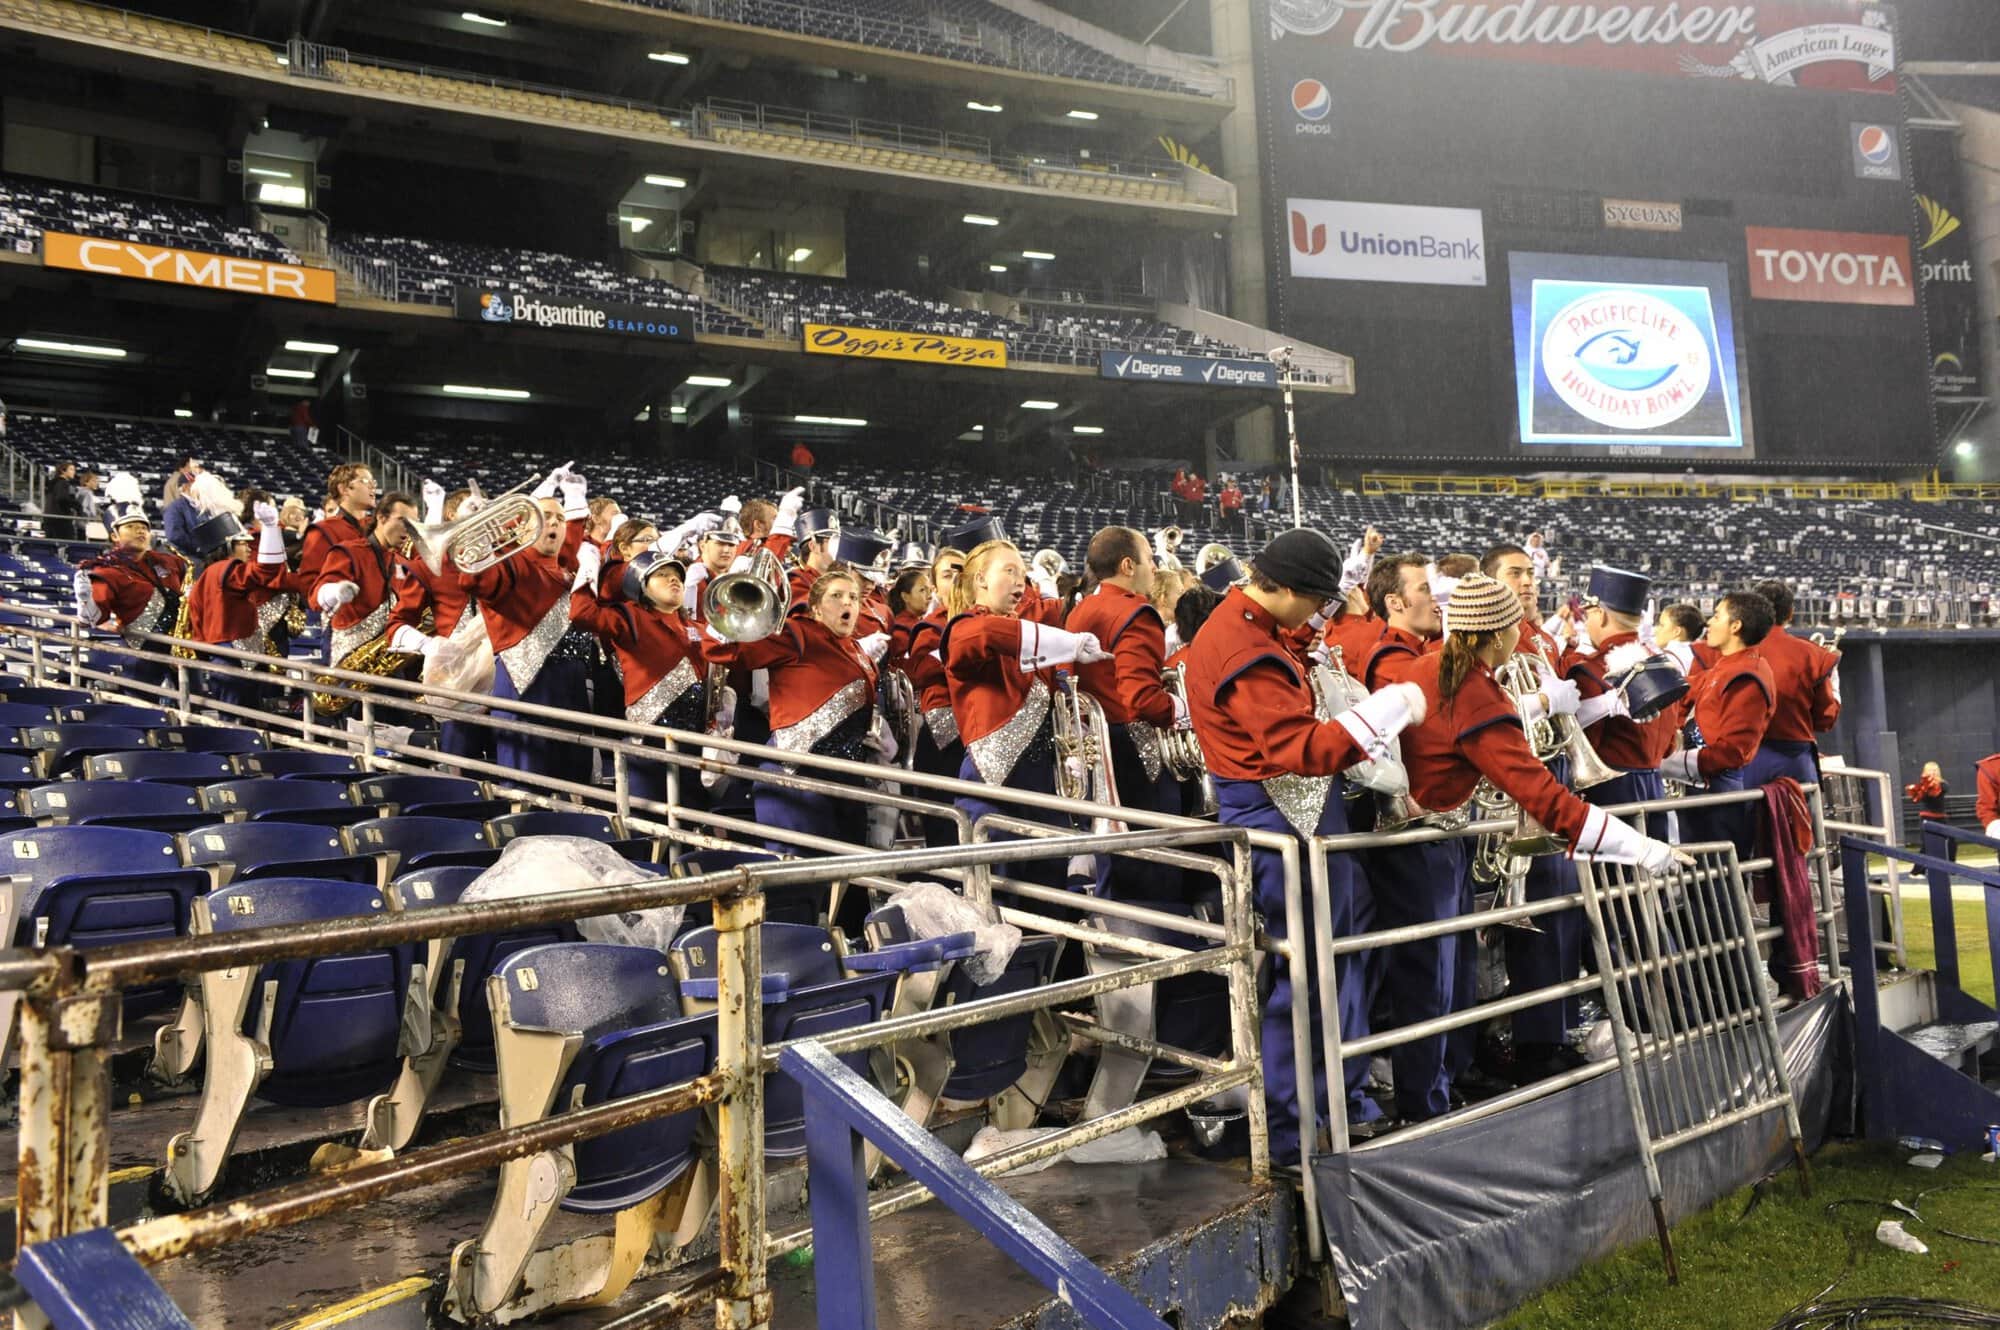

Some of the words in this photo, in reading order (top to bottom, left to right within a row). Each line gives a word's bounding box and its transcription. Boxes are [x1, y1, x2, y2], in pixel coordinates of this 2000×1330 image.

[1353, 0, 1755, 51] Budweiser
[1765, 37, 1839, 71] American
[1841, 34, 1889, 59] Lager
[1606, 205, 1681, 224] SYCUAN
[1340, 231, 1481, 261] UnionBank
[79, 240, 306, 298] CYMER
[1756, 249, 1906, 287] TOYOTA
[1920, 258, 1972, 282] print
[513, 294, 606, 329] Brigantine
[607, 319, 679, 336] SEAFOOD
[812, 328, 906, 355] Oggi's
[909, 336, 999, 362] Pizza
[1131, 359, 1184, 378] Degree
[1217, 365, 1267, 384] Degree
[22, 843, 29, 856] 4
[236, 898, 246, 913] 4
